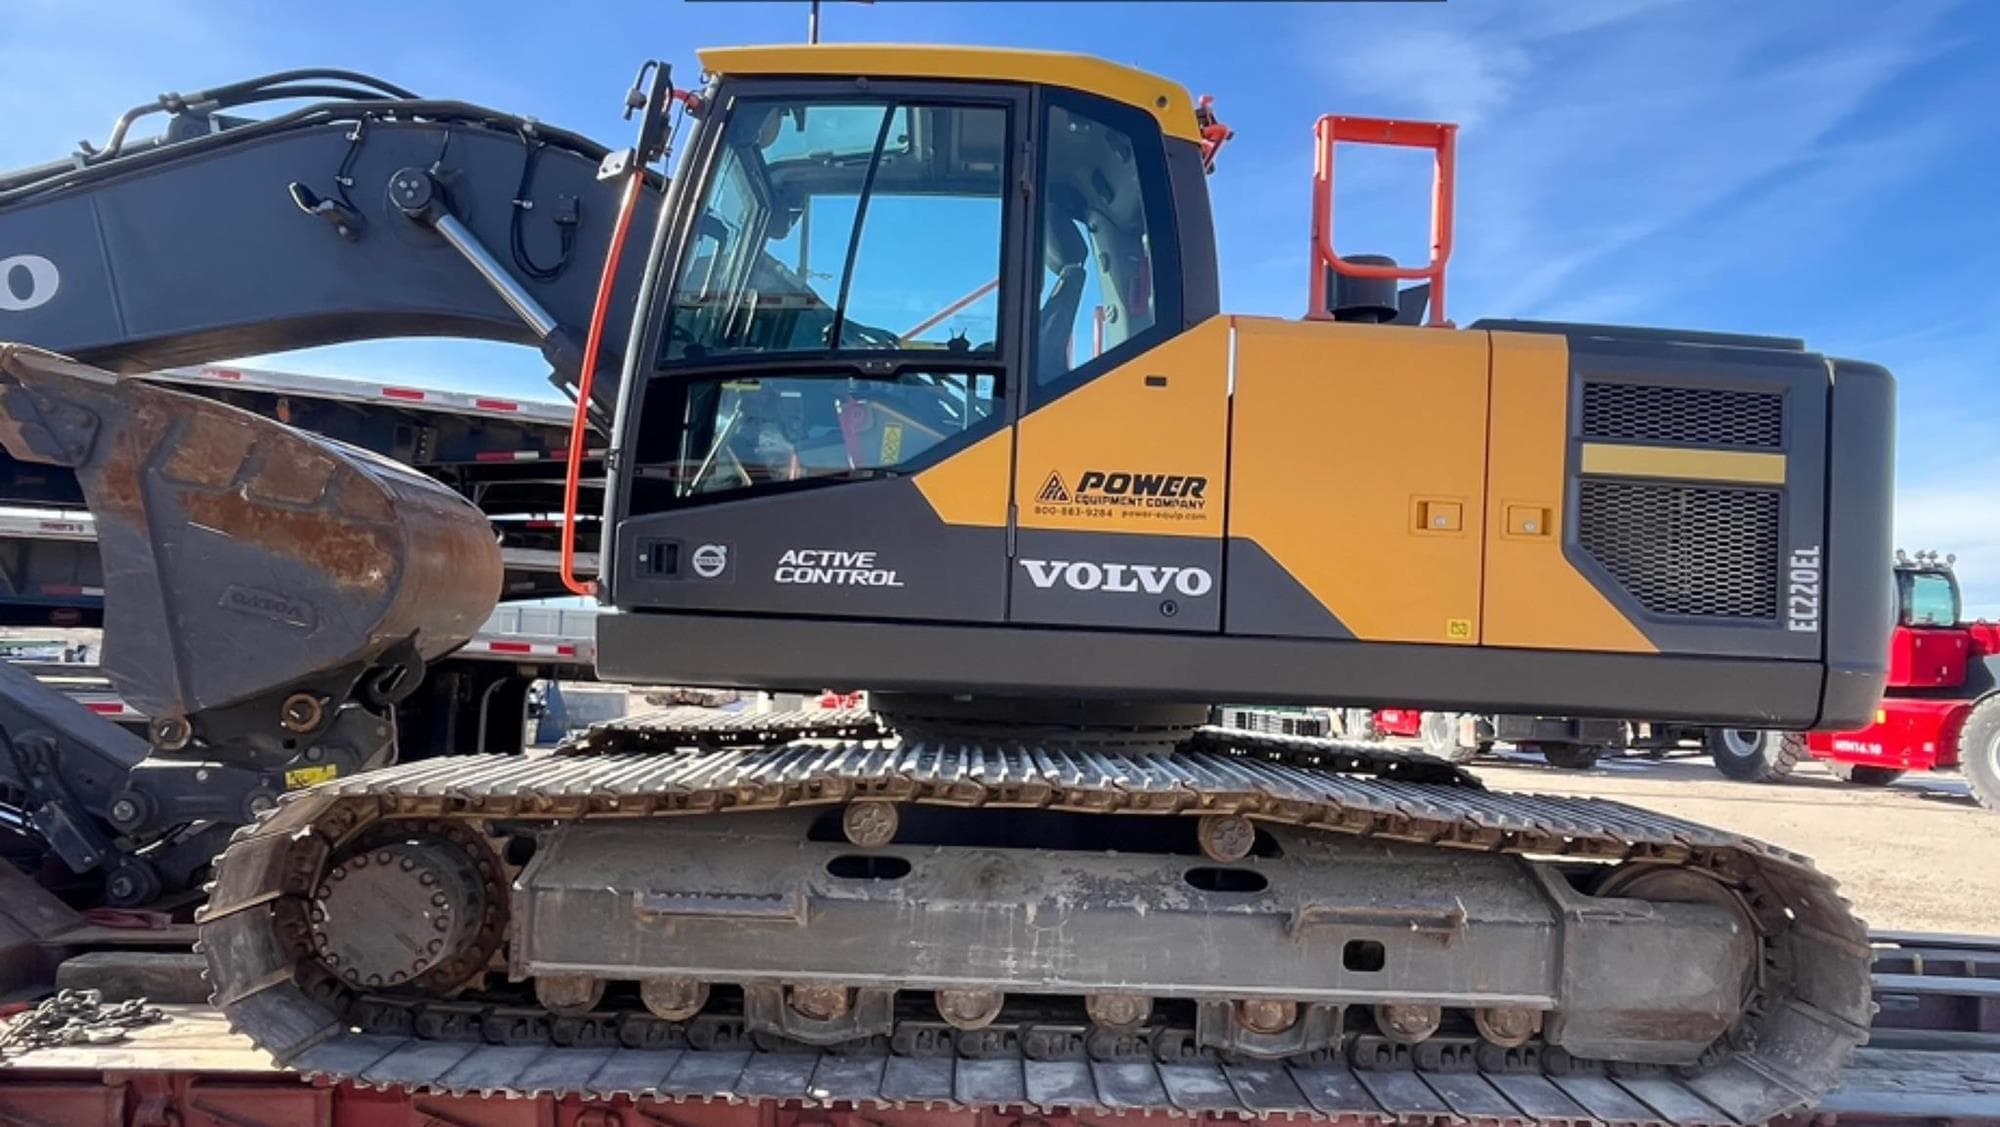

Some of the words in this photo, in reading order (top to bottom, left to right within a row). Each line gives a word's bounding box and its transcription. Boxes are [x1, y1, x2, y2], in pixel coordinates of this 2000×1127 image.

[1076, 471, 1208, 498] POWER
[1075, 494, 1143, 507] EQUIPMENT
[1146, 498, 1206, 509] COMPANY
[778, 549, 877, 568] ACTIVE
[774, 566, 904, 586] CONTROL
[1020, 559, 1212, 596] VOLVO
[1788, 545, 1820, 631] EC220EL
